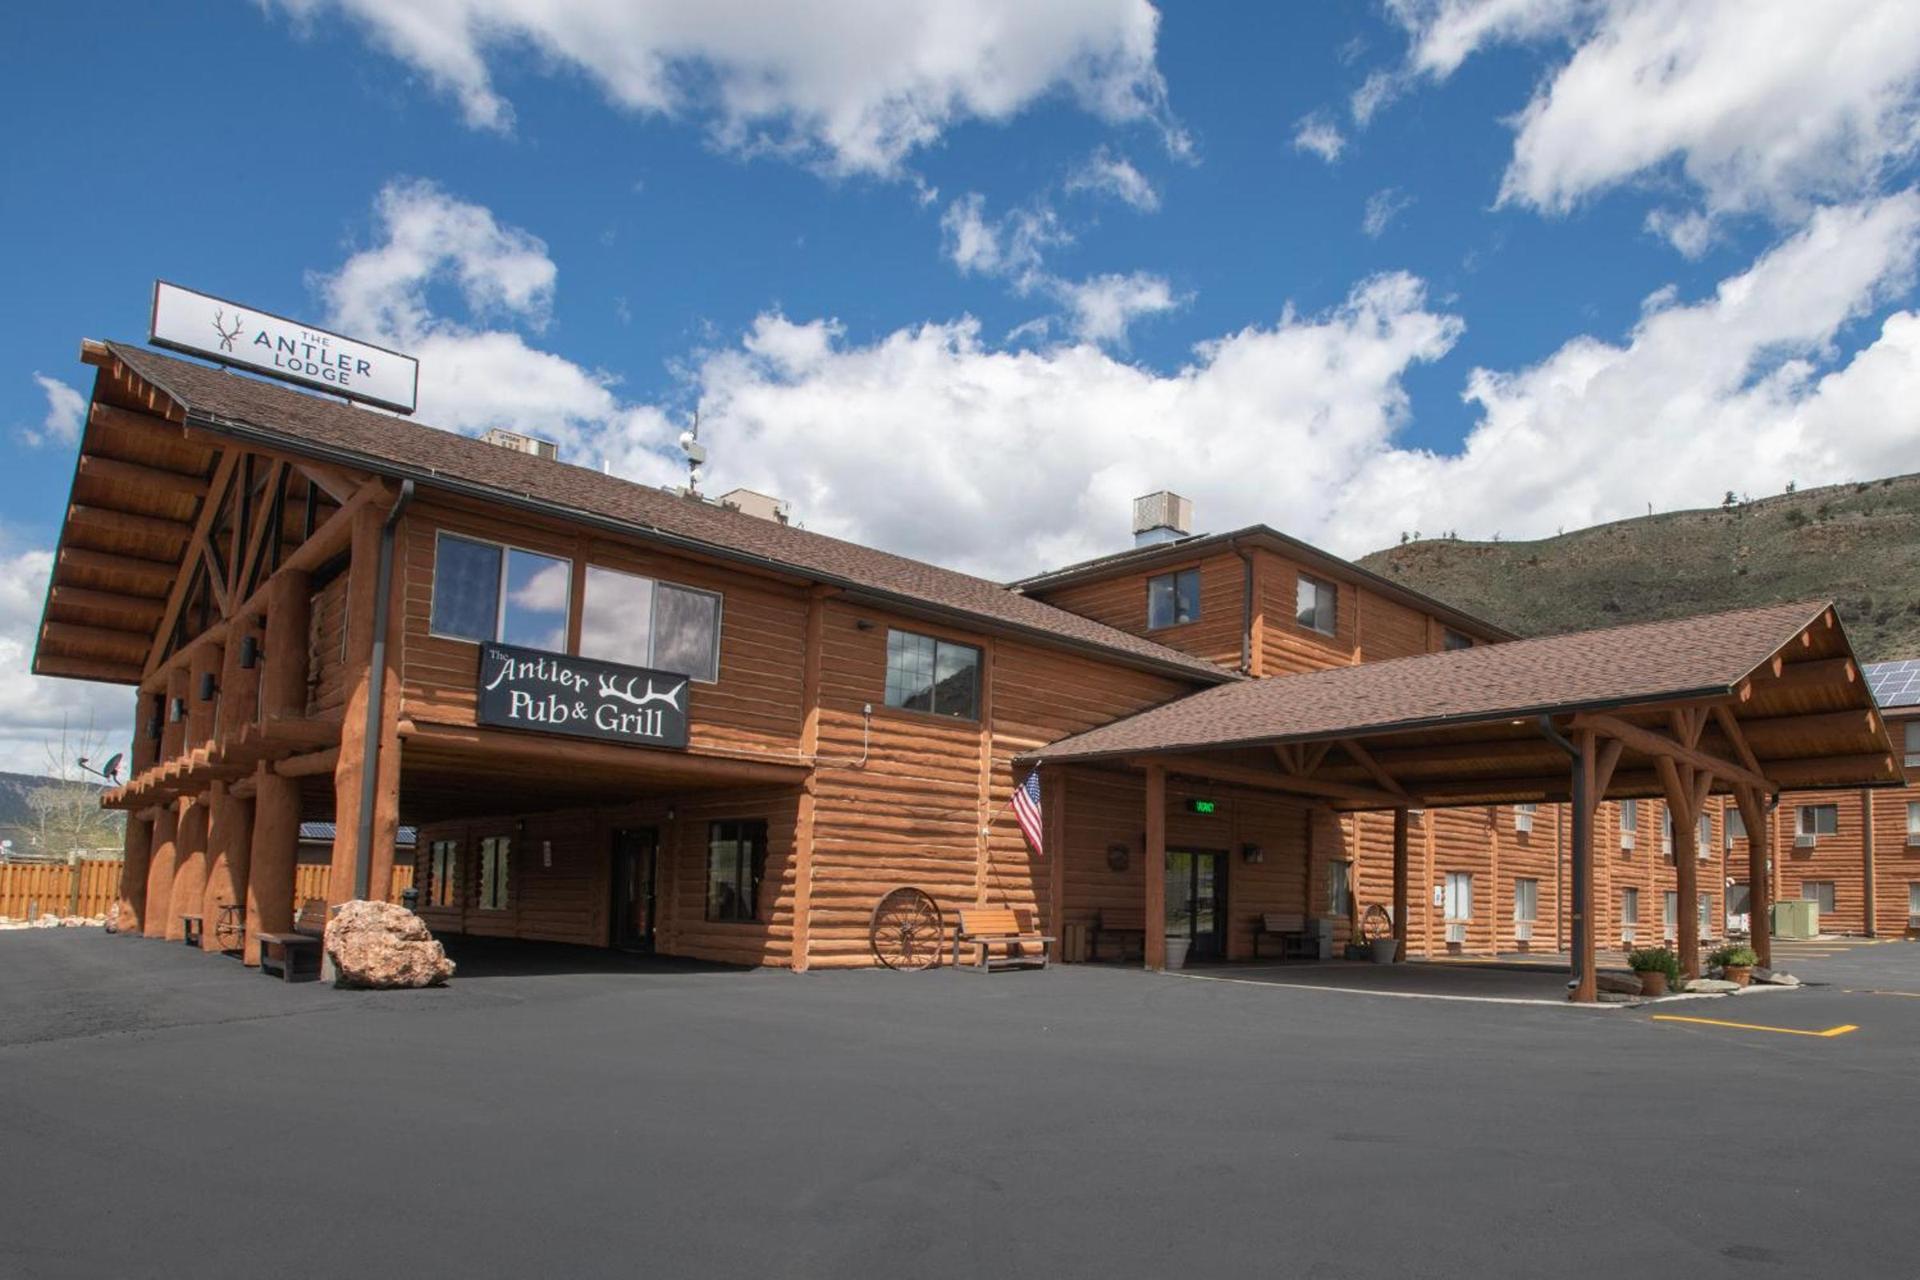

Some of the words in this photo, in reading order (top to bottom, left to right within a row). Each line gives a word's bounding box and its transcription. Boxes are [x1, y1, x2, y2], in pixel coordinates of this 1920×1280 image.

[254, 330, 371, 377] ANTLER
[302, 331, 330, 347] THE
[275, 354, 350, 385] LODGE
[488, 649, 509, 661] The
[486, 657, 590, 693] Antler
[508, 690, 569, 724] Pub
[571, 701, 589, 720] &
[595, 704, 664, 738] Grill
